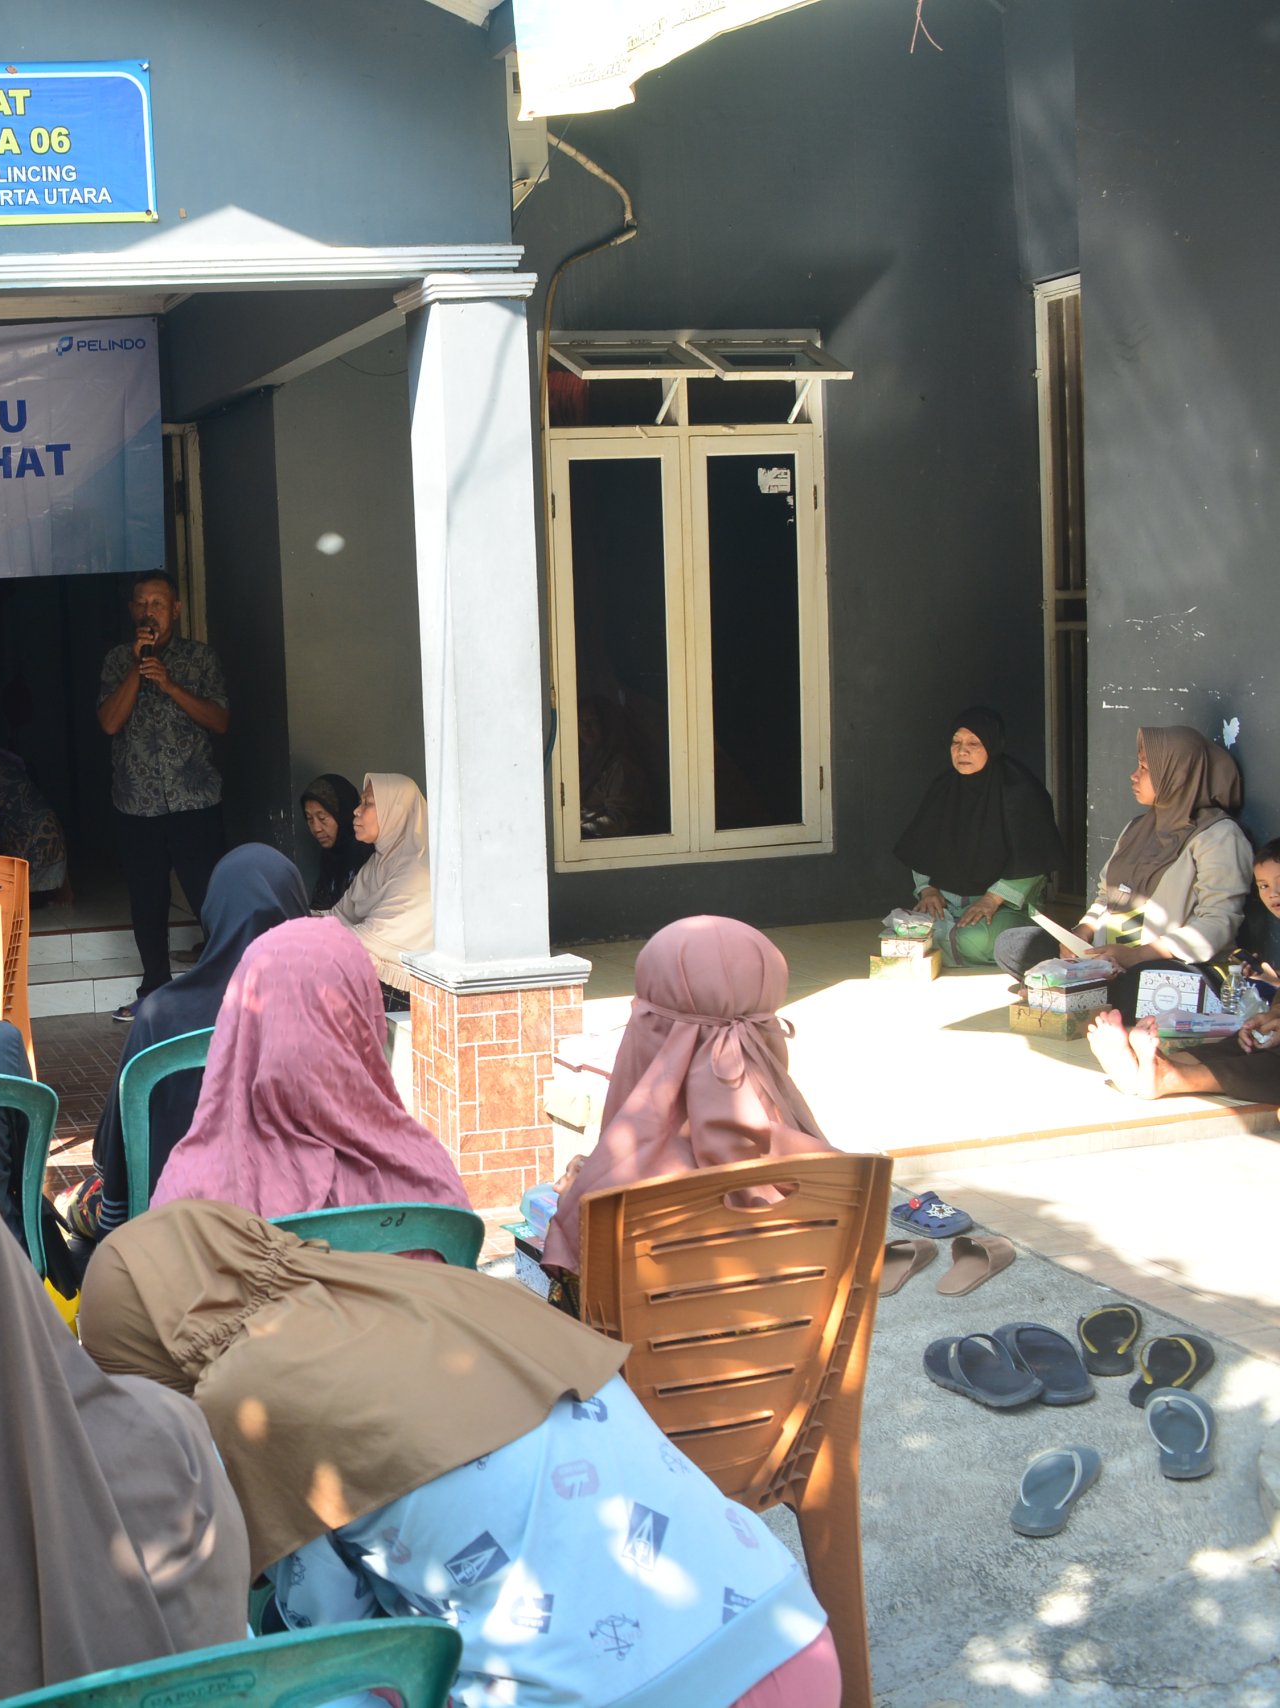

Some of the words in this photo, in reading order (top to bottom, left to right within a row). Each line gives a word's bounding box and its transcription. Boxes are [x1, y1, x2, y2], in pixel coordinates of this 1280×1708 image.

[29, 126, 72, 155] 06
[43, 186, 112, 205] UTARA
[76, 338, 146, 352] PELINDO
